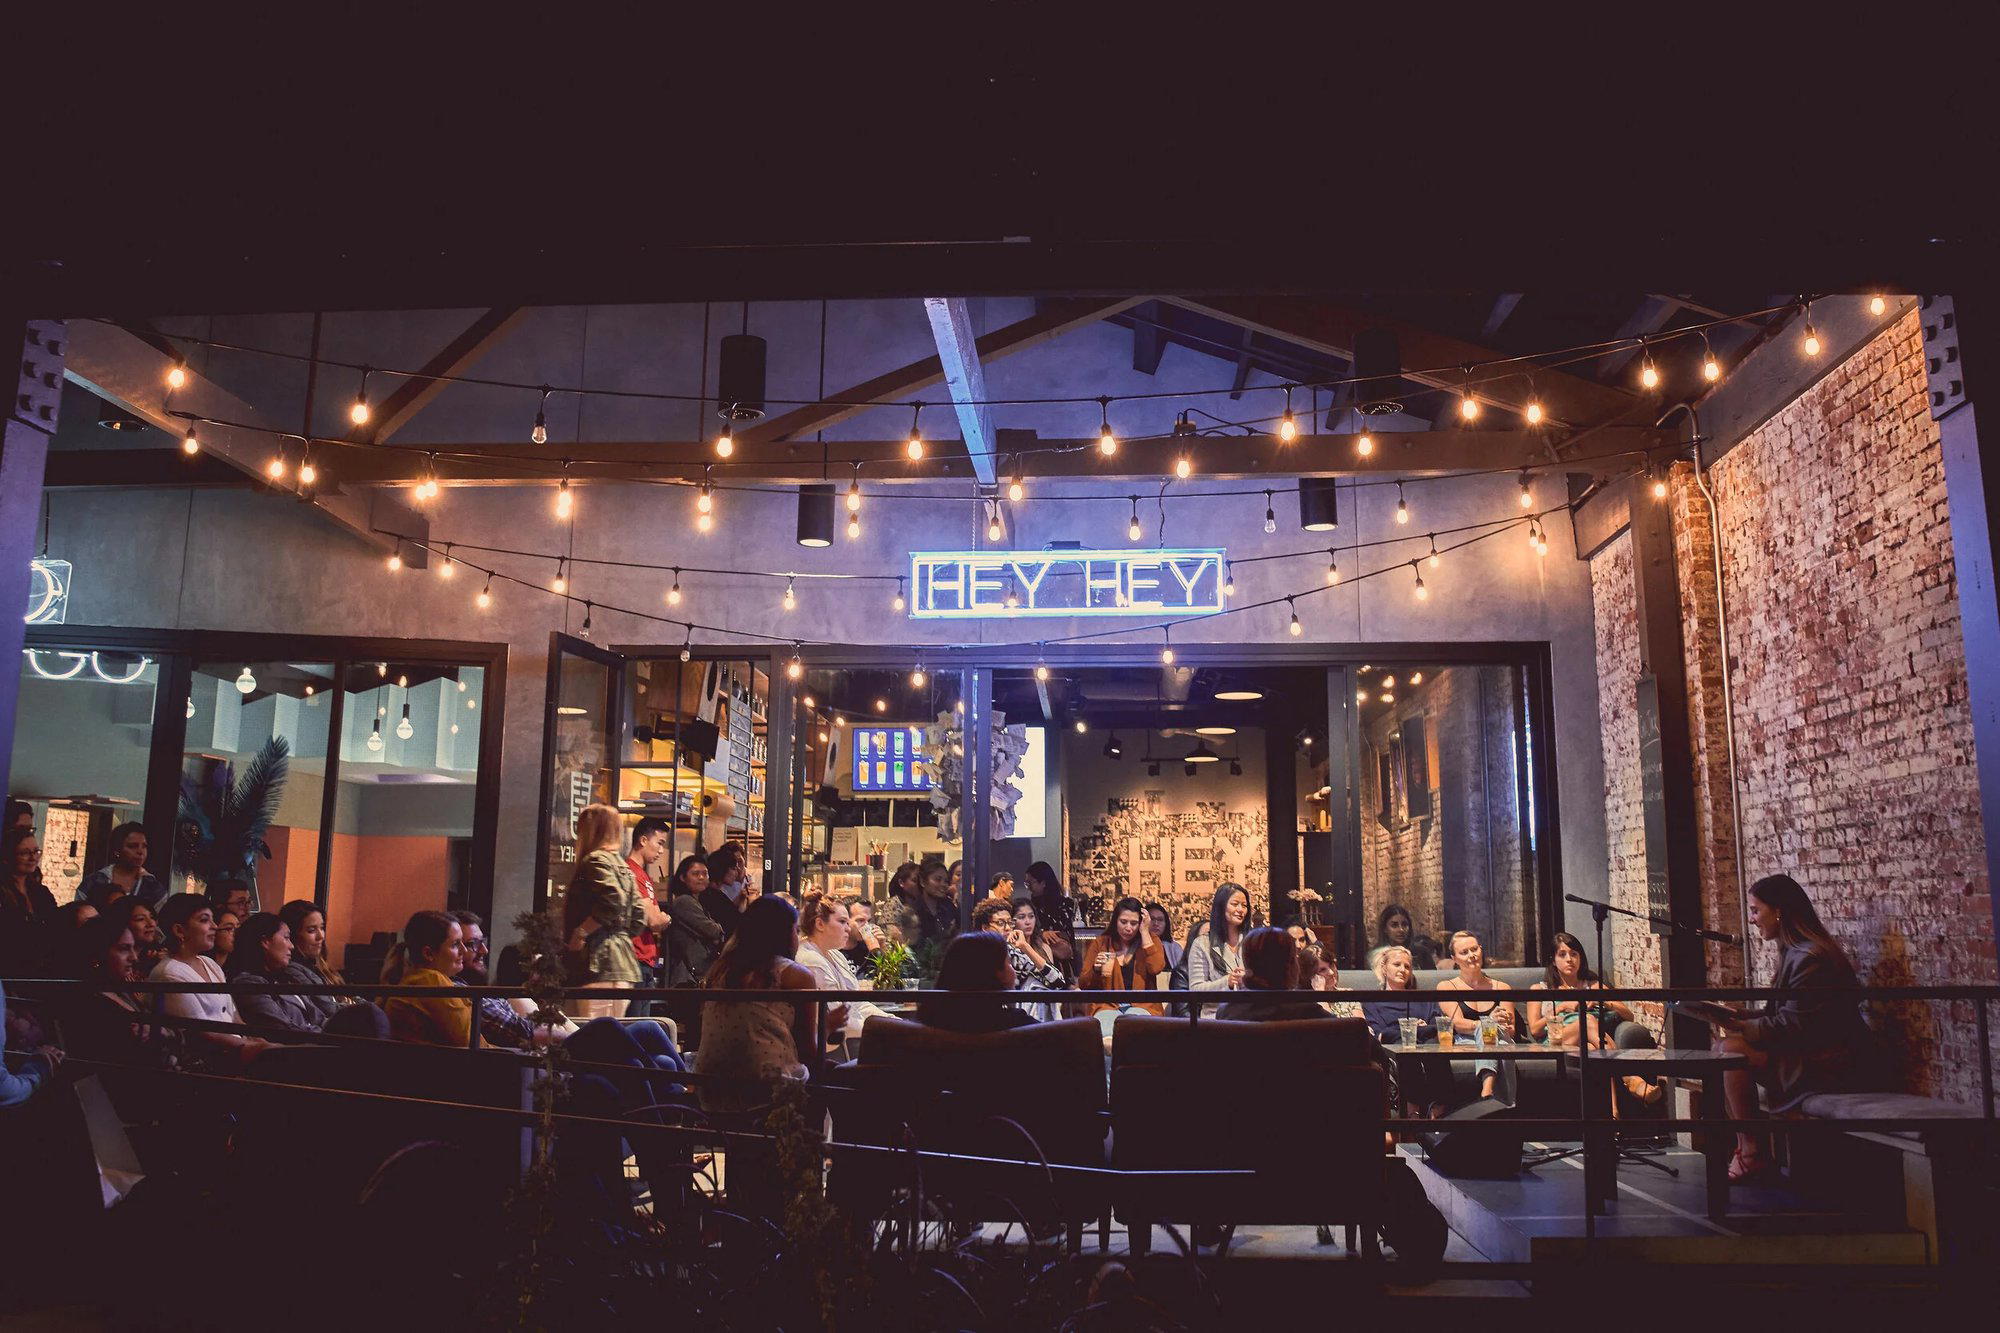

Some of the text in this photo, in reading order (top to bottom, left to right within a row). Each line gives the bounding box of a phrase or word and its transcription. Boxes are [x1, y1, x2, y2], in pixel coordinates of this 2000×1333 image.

[927, 557, 1209, 610] HEY HEY
[1128, 836, 1265, 895] HEY
